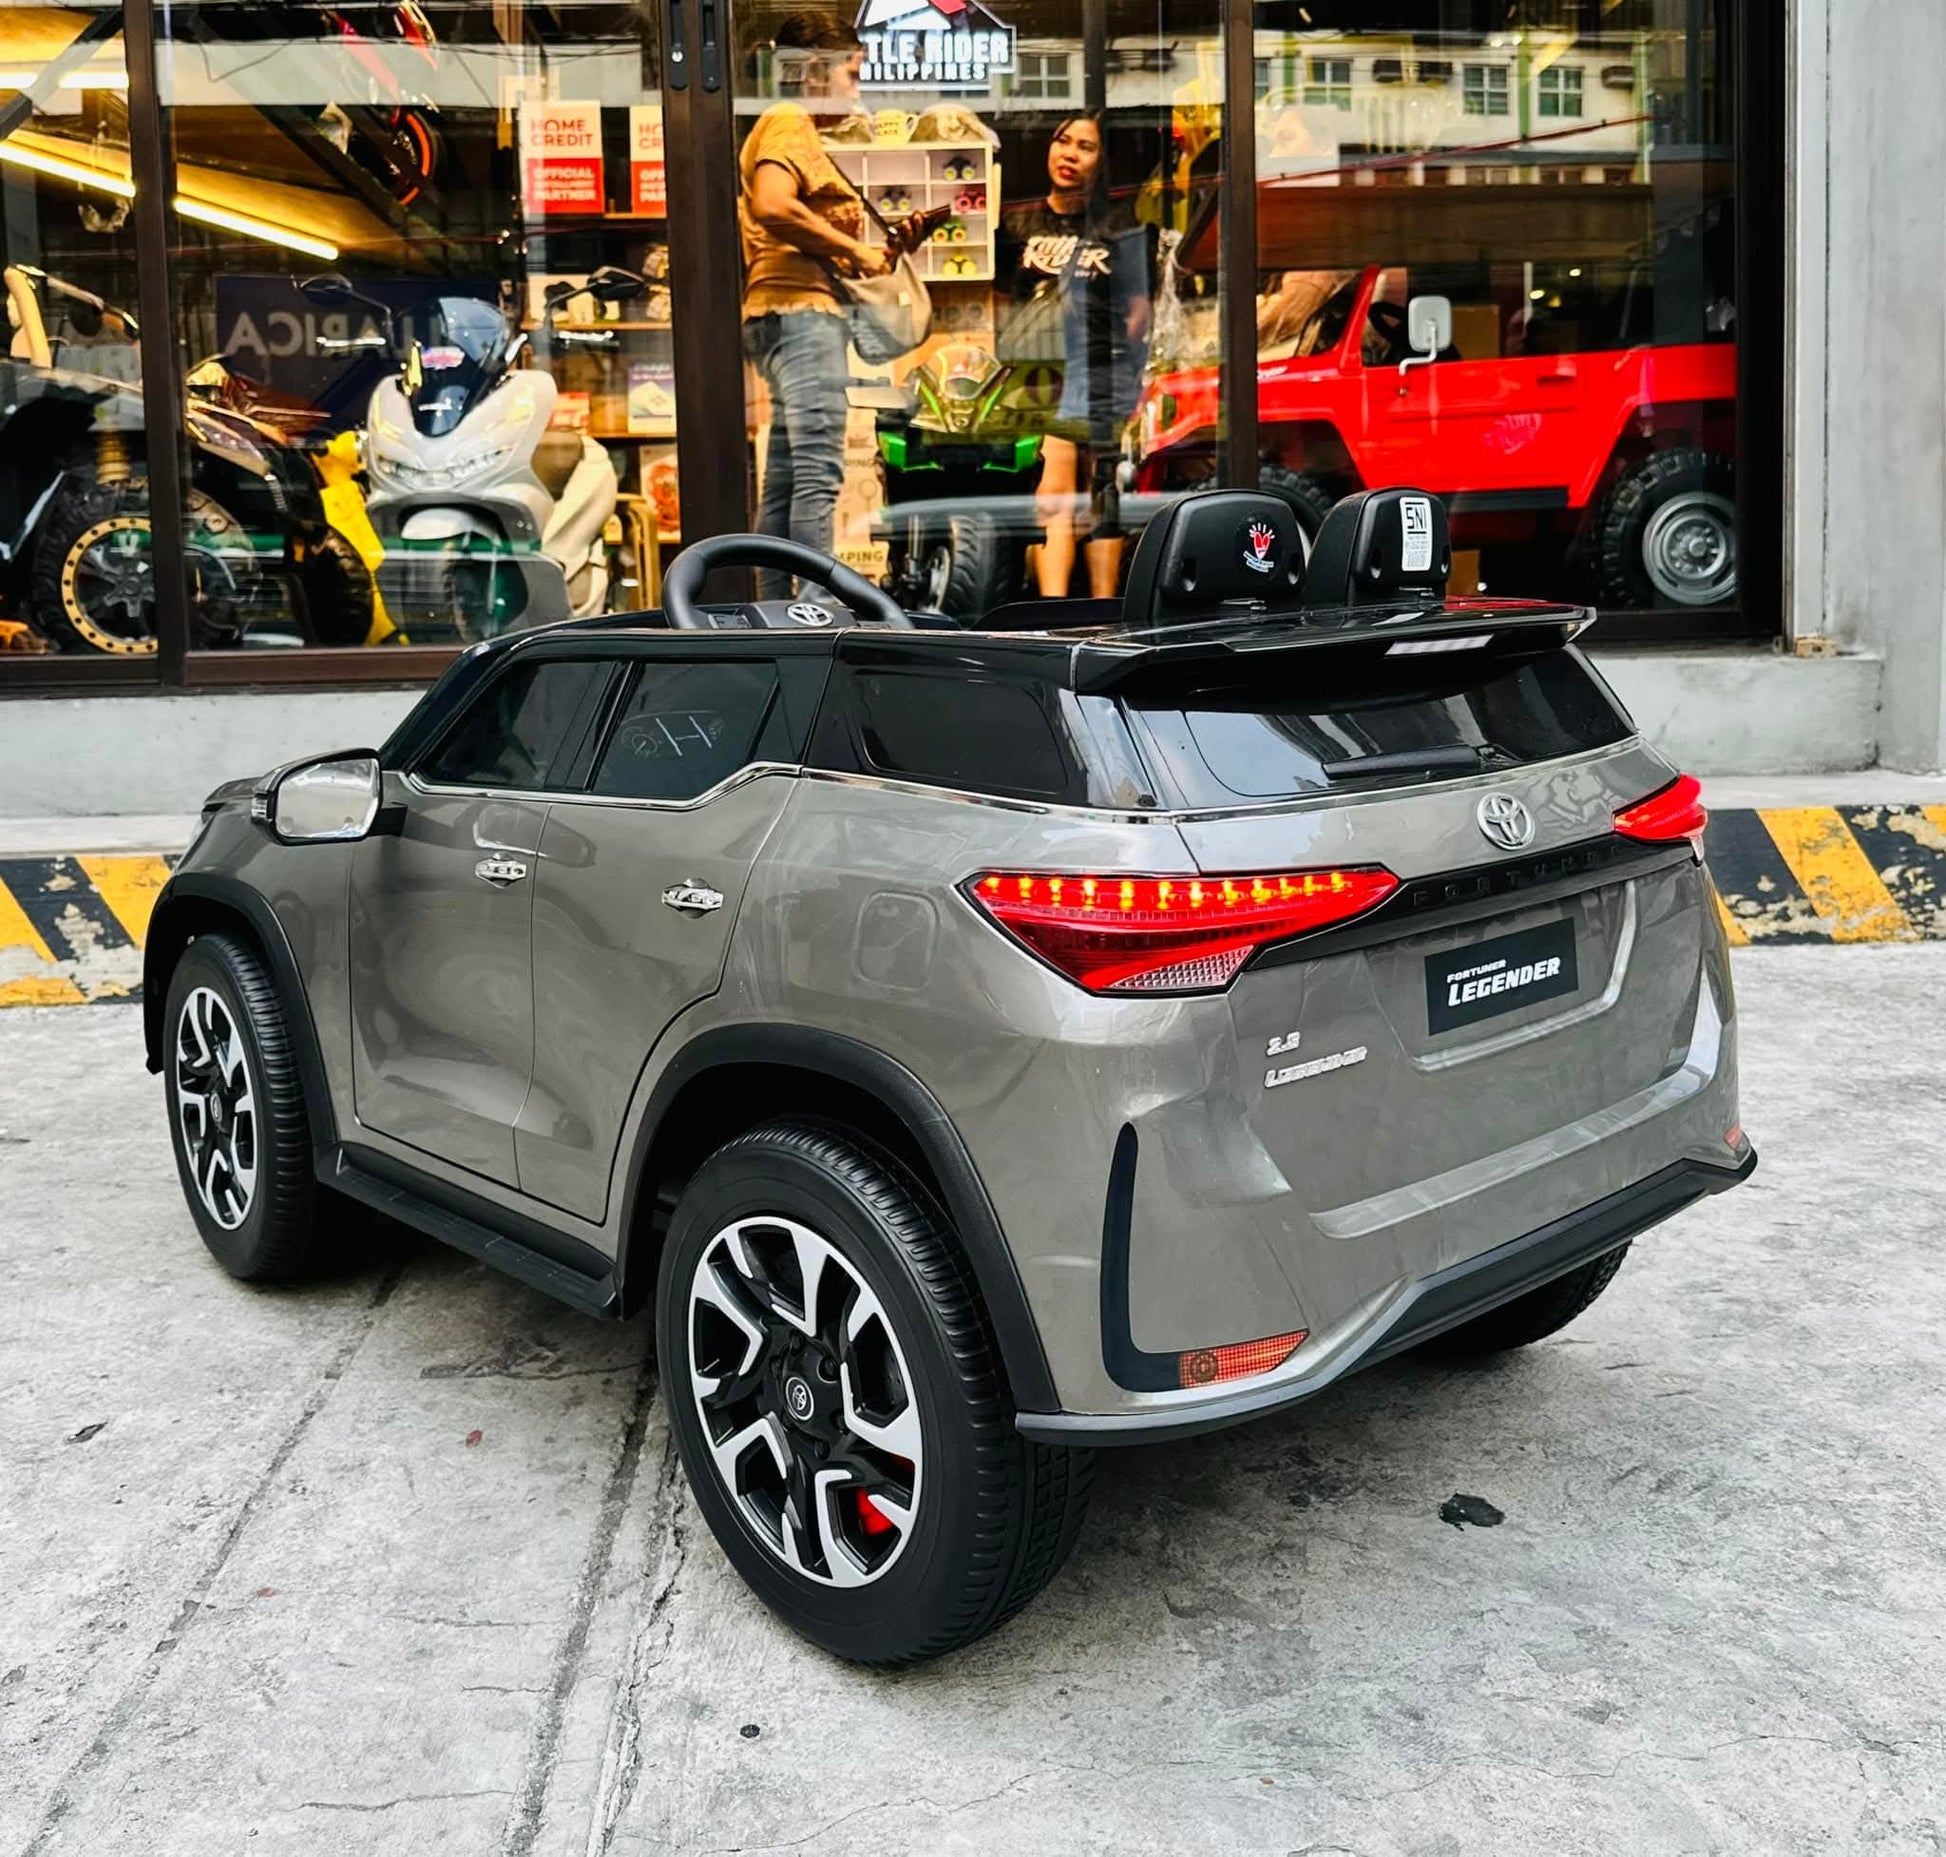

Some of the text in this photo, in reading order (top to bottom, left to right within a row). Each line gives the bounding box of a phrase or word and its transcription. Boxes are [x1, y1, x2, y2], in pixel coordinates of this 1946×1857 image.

[857, 31, 1009, 63] TLE RIDER
[531, 119, 586, 132] HOME
[531, 134, 594, 147] CREDIT
[1406, 506, 1428, 530] SNI
[1446, 959, 1507, 983] FORTUNER
[1447, 956, 1561, 1007] LEGENDER
